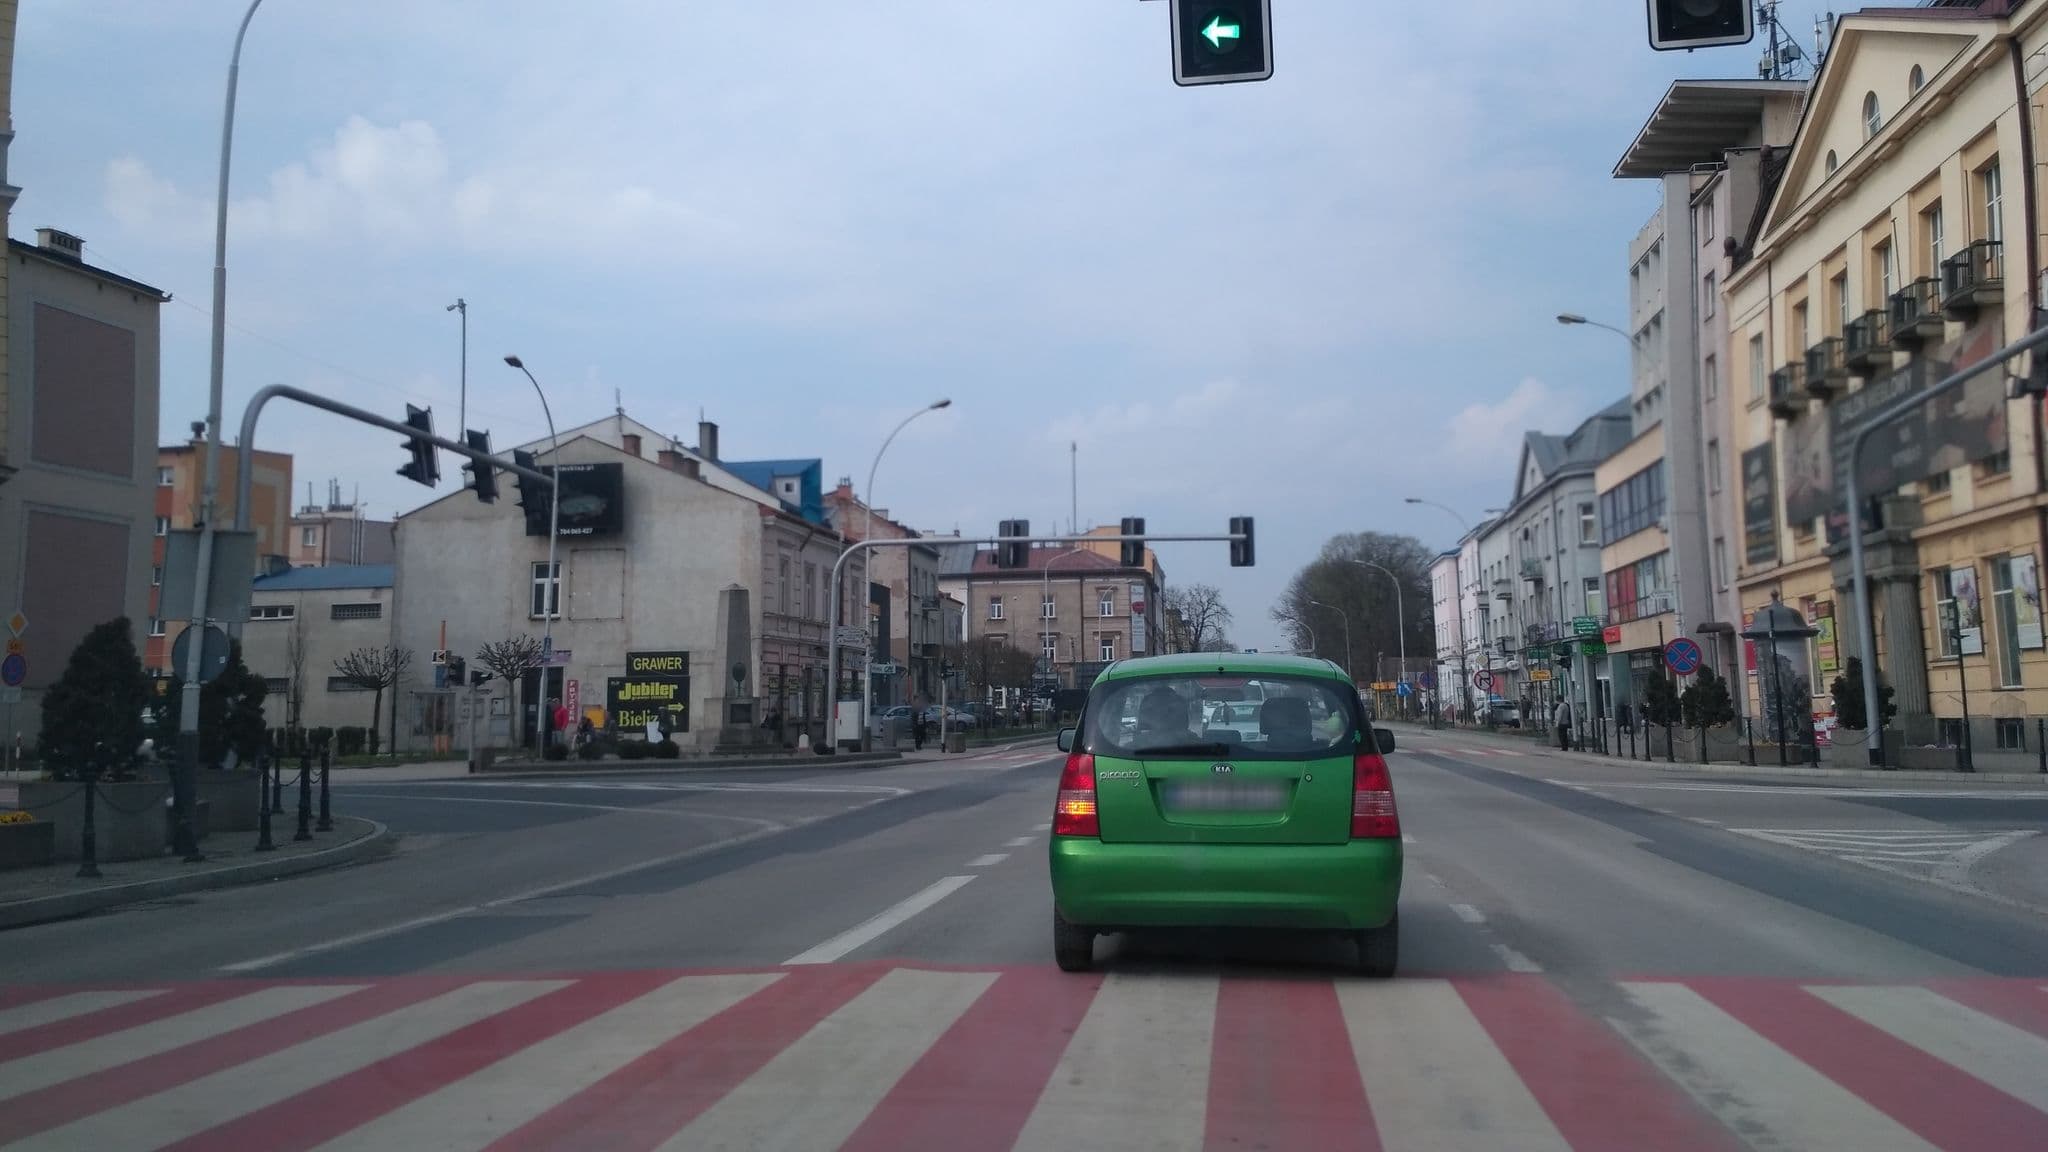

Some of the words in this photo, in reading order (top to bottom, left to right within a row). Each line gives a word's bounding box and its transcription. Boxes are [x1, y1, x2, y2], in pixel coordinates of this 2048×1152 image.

[633, 656, 682, 671] GRAWER
[618, 682, 678, 700] Jubiler
[618, 709, 677, 727] Bieliza
[1214, 765, 1232, 773] KIA
